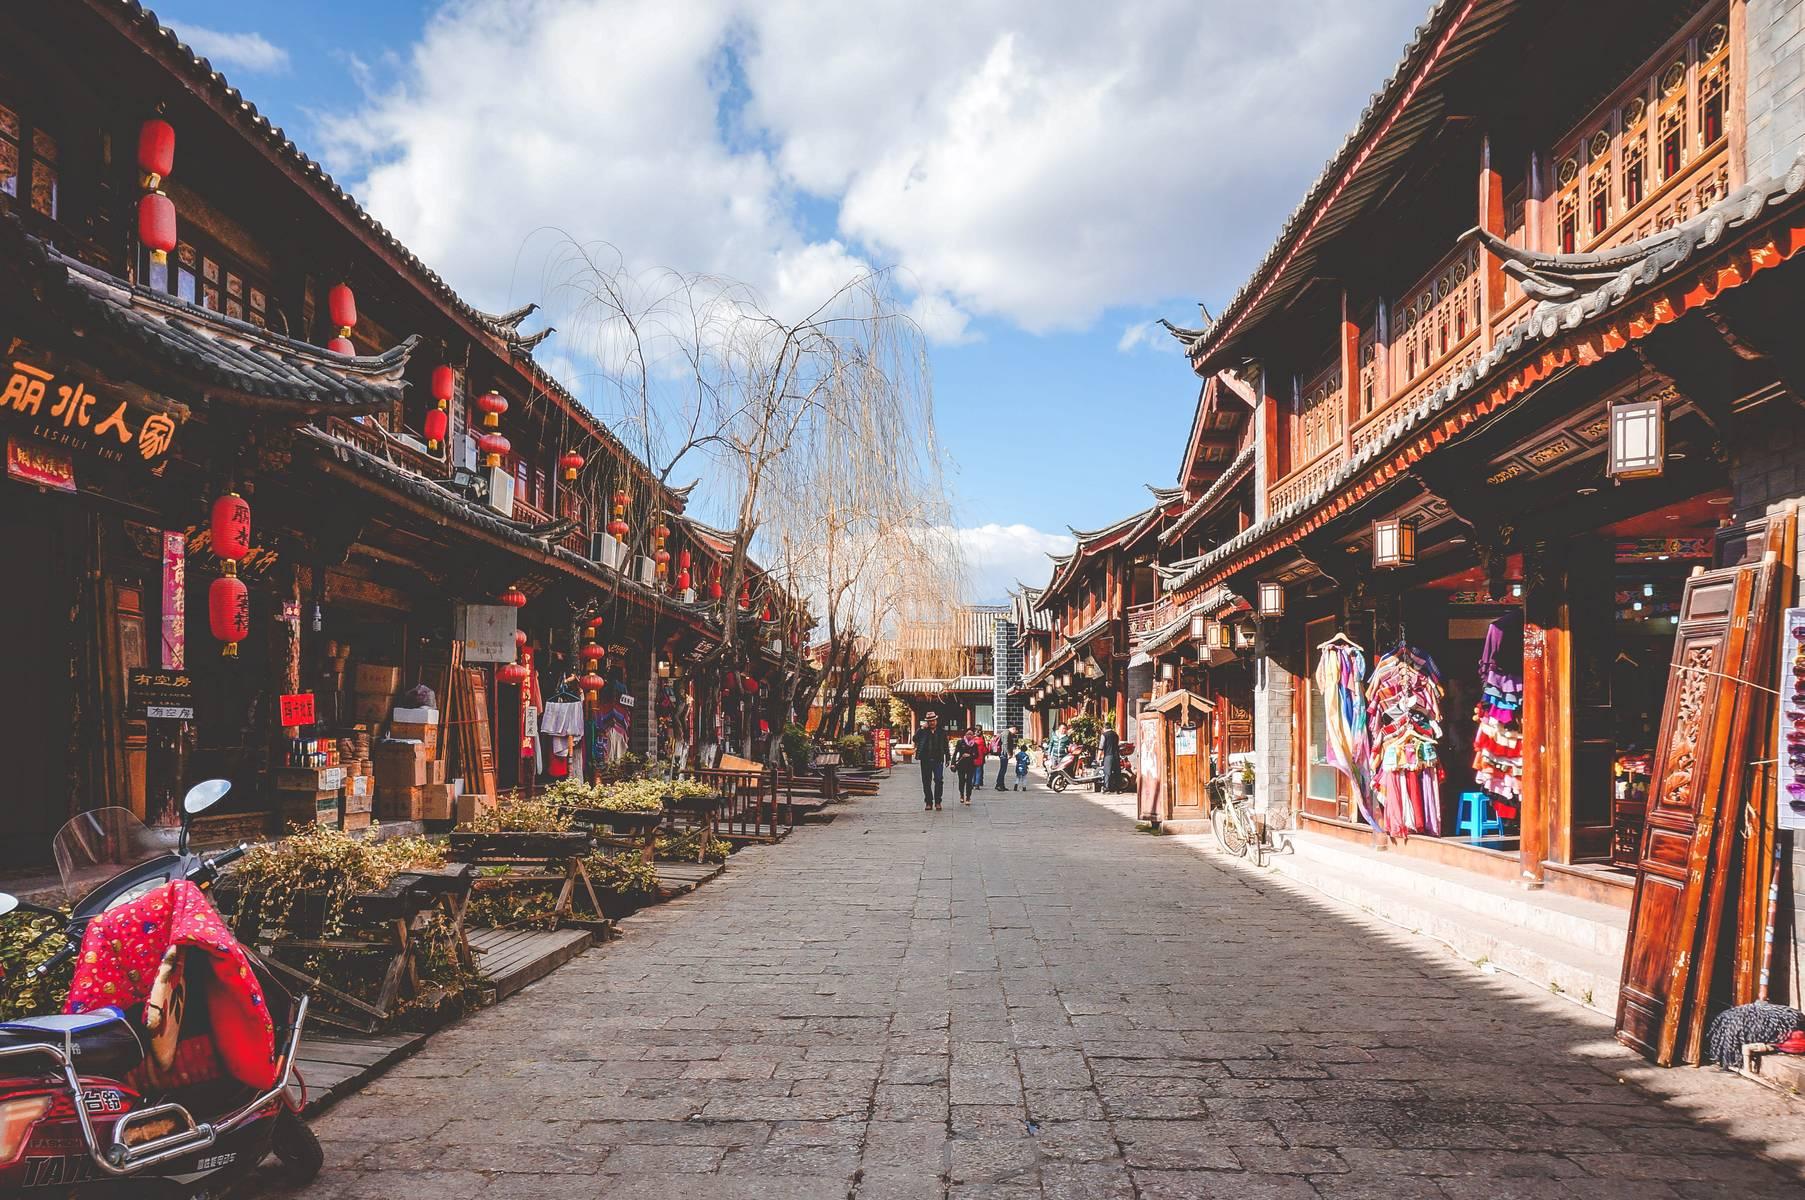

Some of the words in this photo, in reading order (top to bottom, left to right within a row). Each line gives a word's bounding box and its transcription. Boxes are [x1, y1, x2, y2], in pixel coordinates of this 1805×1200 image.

[0, 361, 175, 460] 丽水人家
[33, 424, 87, 450] LISHUI
[98, 447, 123, 462] INN
[134, 674, 192, 687] 有空房
